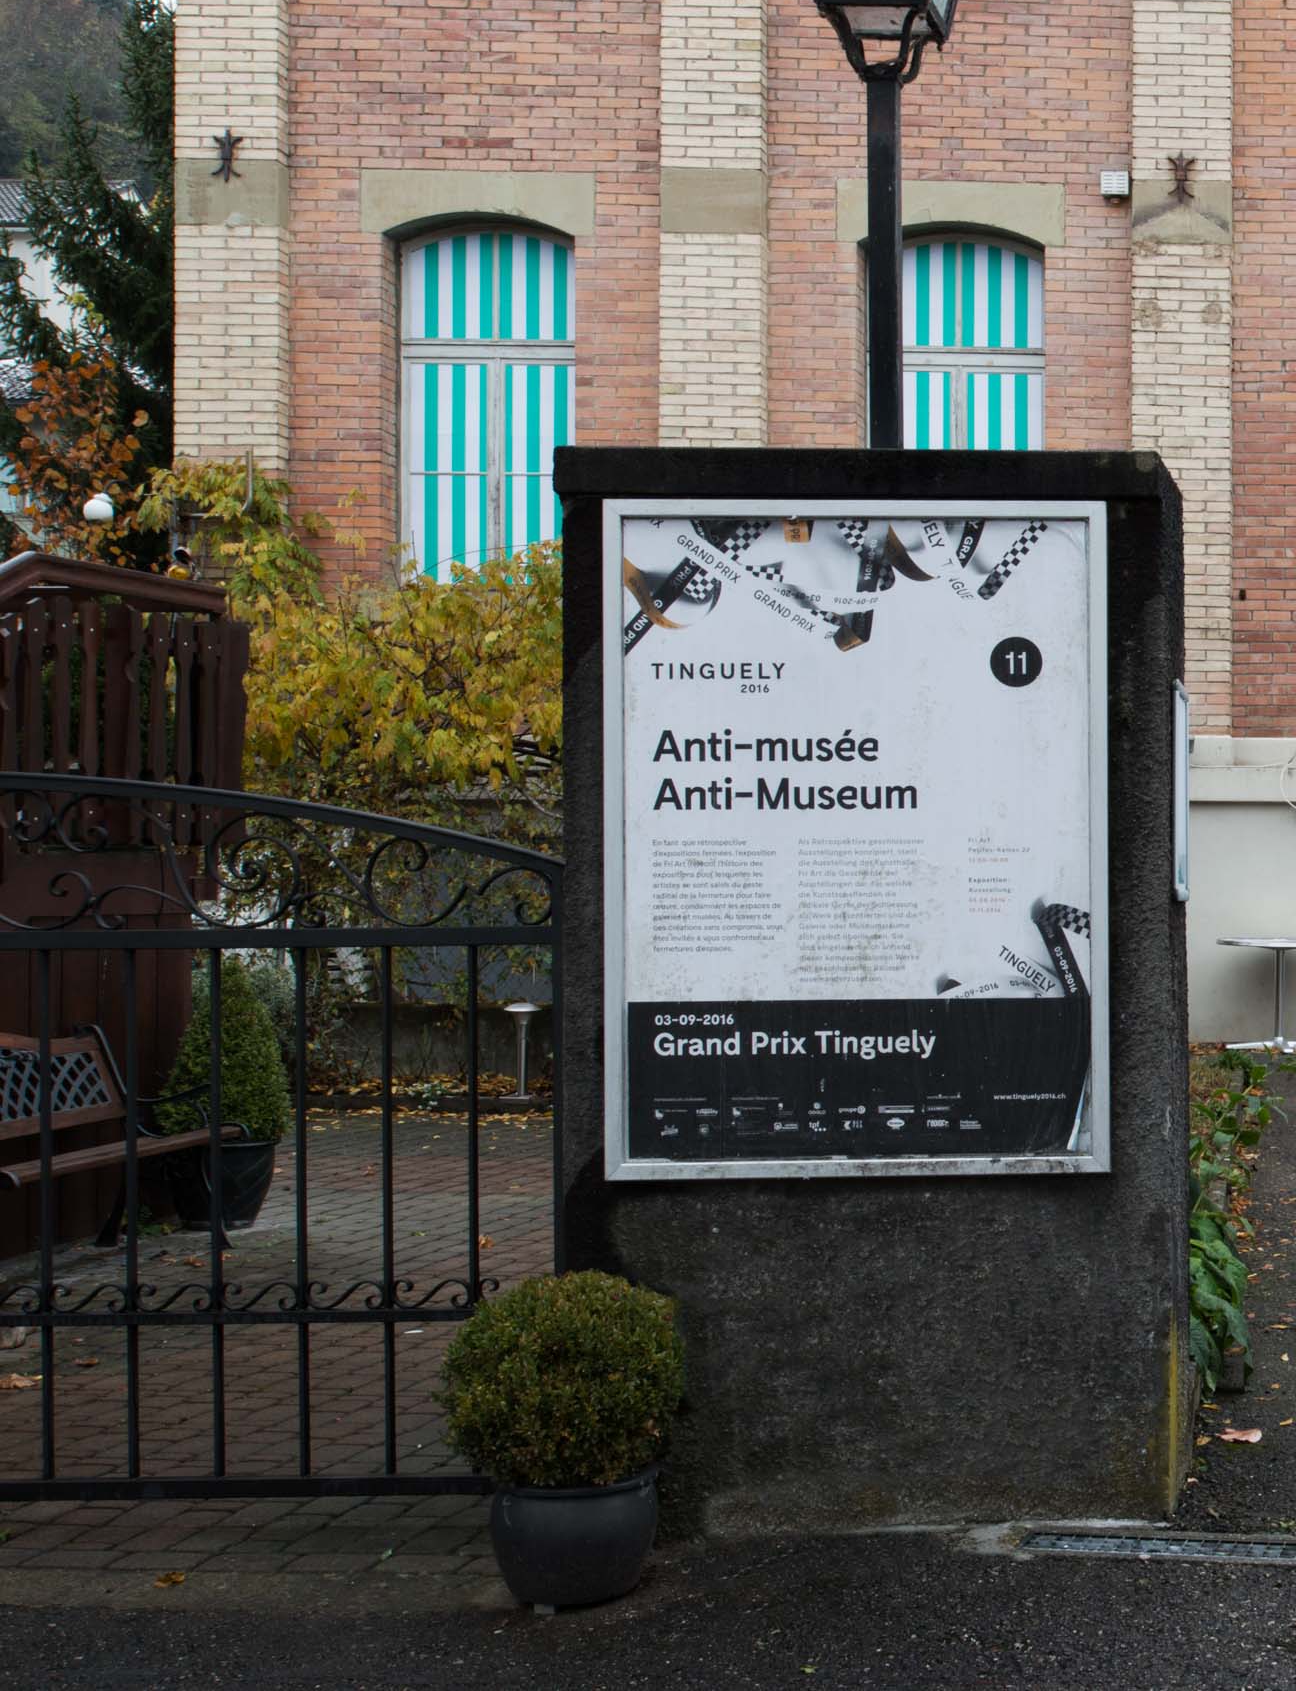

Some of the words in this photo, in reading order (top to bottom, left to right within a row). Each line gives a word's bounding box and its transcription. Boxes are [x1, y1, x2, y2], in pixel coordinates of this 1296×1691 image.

[677, 534, 714, 565] GRAND
[713, 555, 741, 584] PRIX
[753, 589, 791, 619] GRAND
[791, 612, 816, 633] PRIX
[651, 662, 785, 680] TINGUELY
[1005, 651, 1028, 675] 11
[740, 684, 770, 693] 2016
[653, 729, 879, 763] Anti-musée
[653, 777, 918, 810] Anti-Museum
[998, 945, 1056, 993] TINGUELY
[1054, 946, 1078, 993] 03-09-2016
[655, 1014, 734, 1025] 03-09-2016
[653, 1031, 741, 1056] Grand
[751, 1030, 807, 1055] Prix
[814, 1029, 936, 1059] Tinguely
[993, 1093, 1066, 1101] www.tinguely2016.ch
